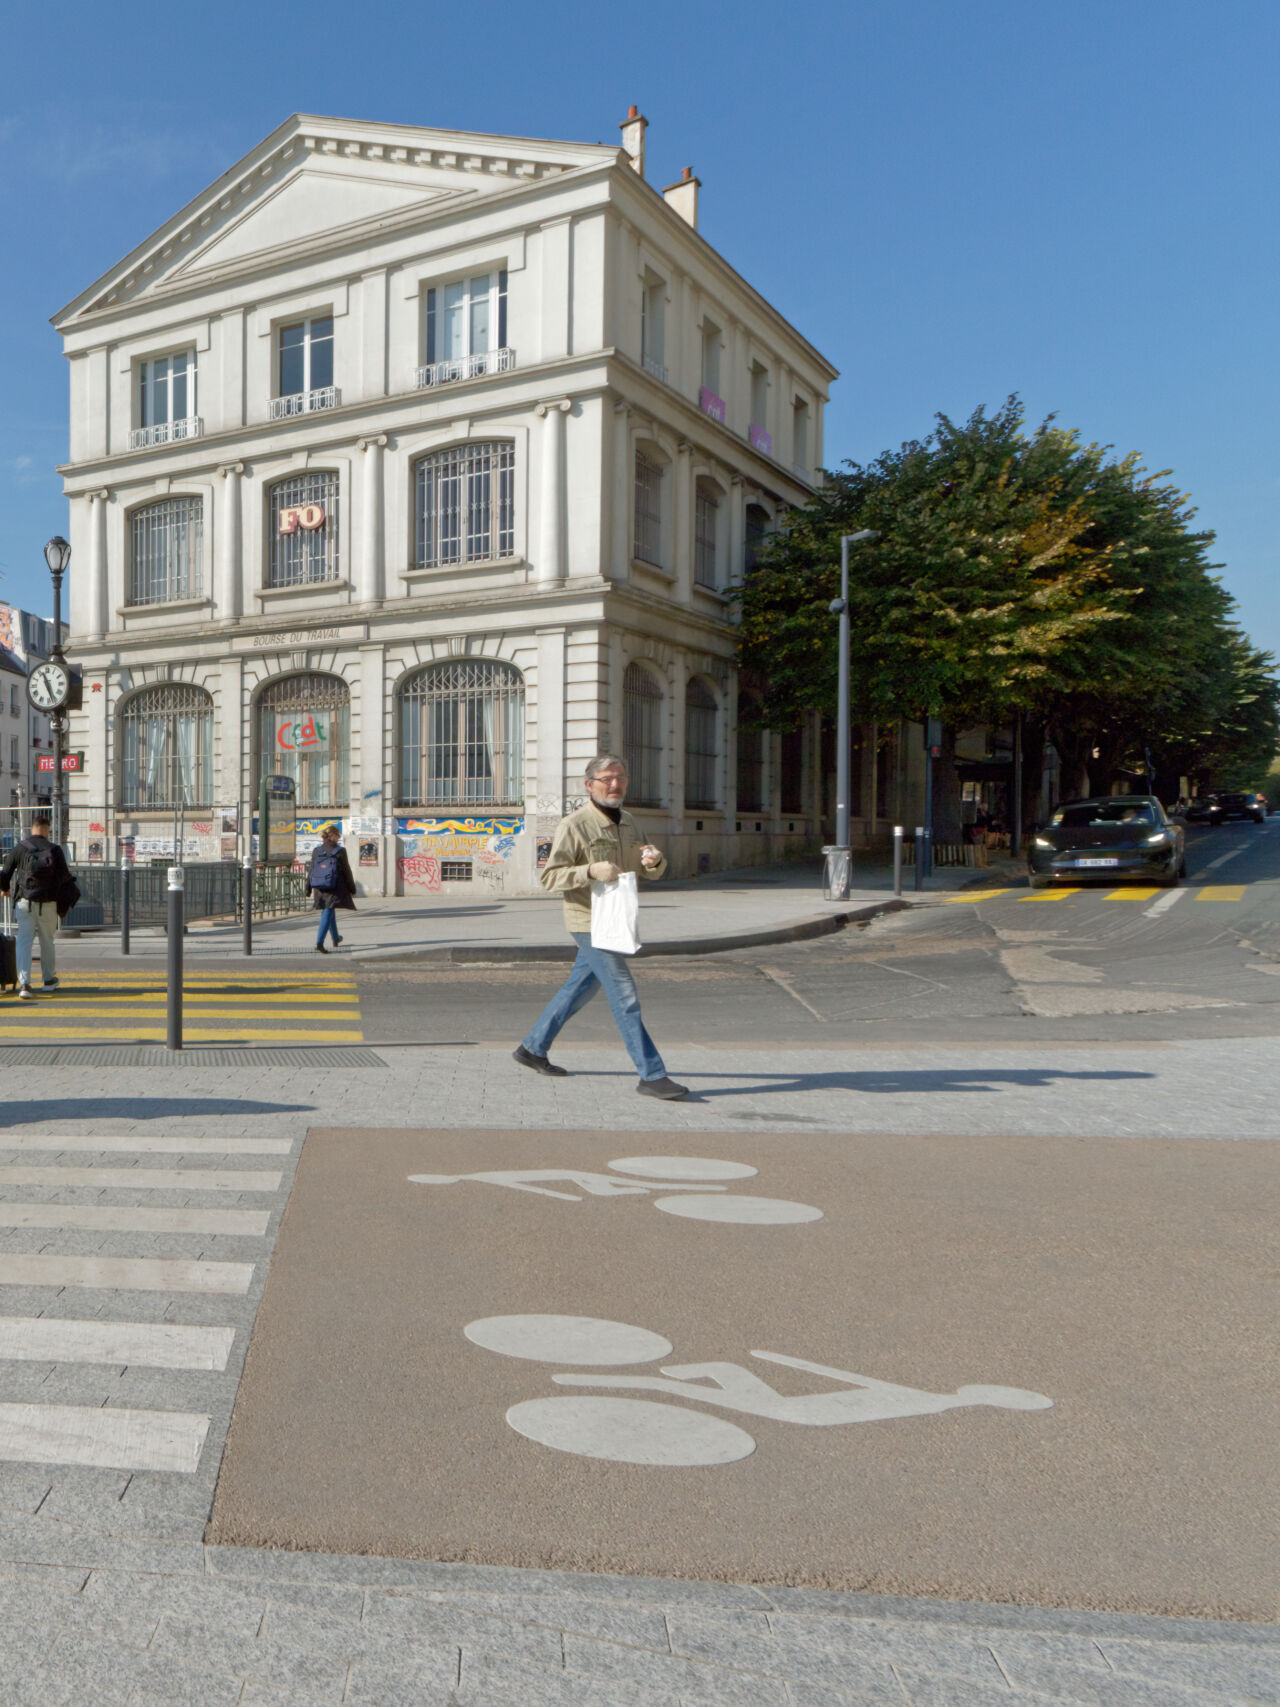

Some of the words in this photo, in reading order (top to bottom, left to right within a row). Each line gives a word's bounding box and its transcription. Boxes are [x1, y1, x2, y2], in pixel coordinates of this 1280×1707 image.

[279, 504, 325, 534] FO
[253, 633, 286, 647] BOURSE
[290, 630, 302, 643] DU
[307, 628, 341, 641] TRAVAIL
[40, 758, 76, 769] MERO
